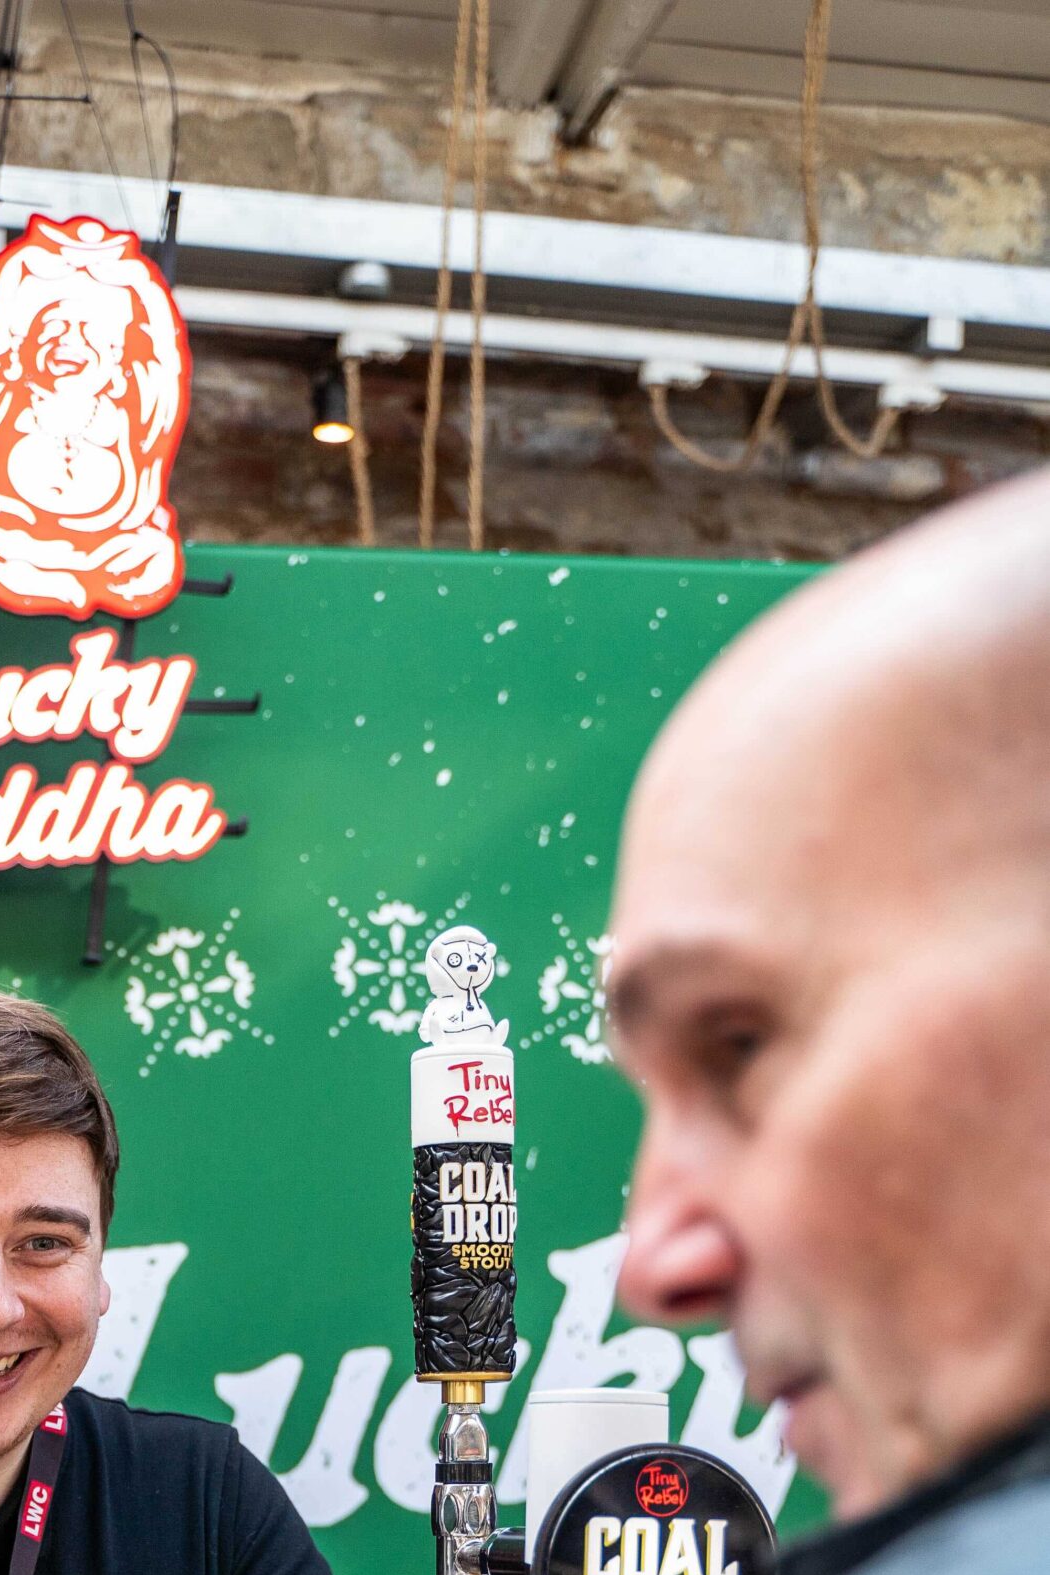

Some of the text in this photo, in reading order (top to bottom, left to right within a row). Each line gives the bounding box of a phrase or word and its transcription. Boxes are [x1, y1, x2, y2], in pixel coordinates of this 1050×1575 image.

[448, 1061, 513, 1104] Tiny
[460, 1257, 511, 1270] STOUT
[45, 1401, 64, 1431] LW
[642, 1466, 680, 1489] Tiny
[24, 1485, 49, 1537] LWC
[639, 1487, 685, 1510] Rebel
